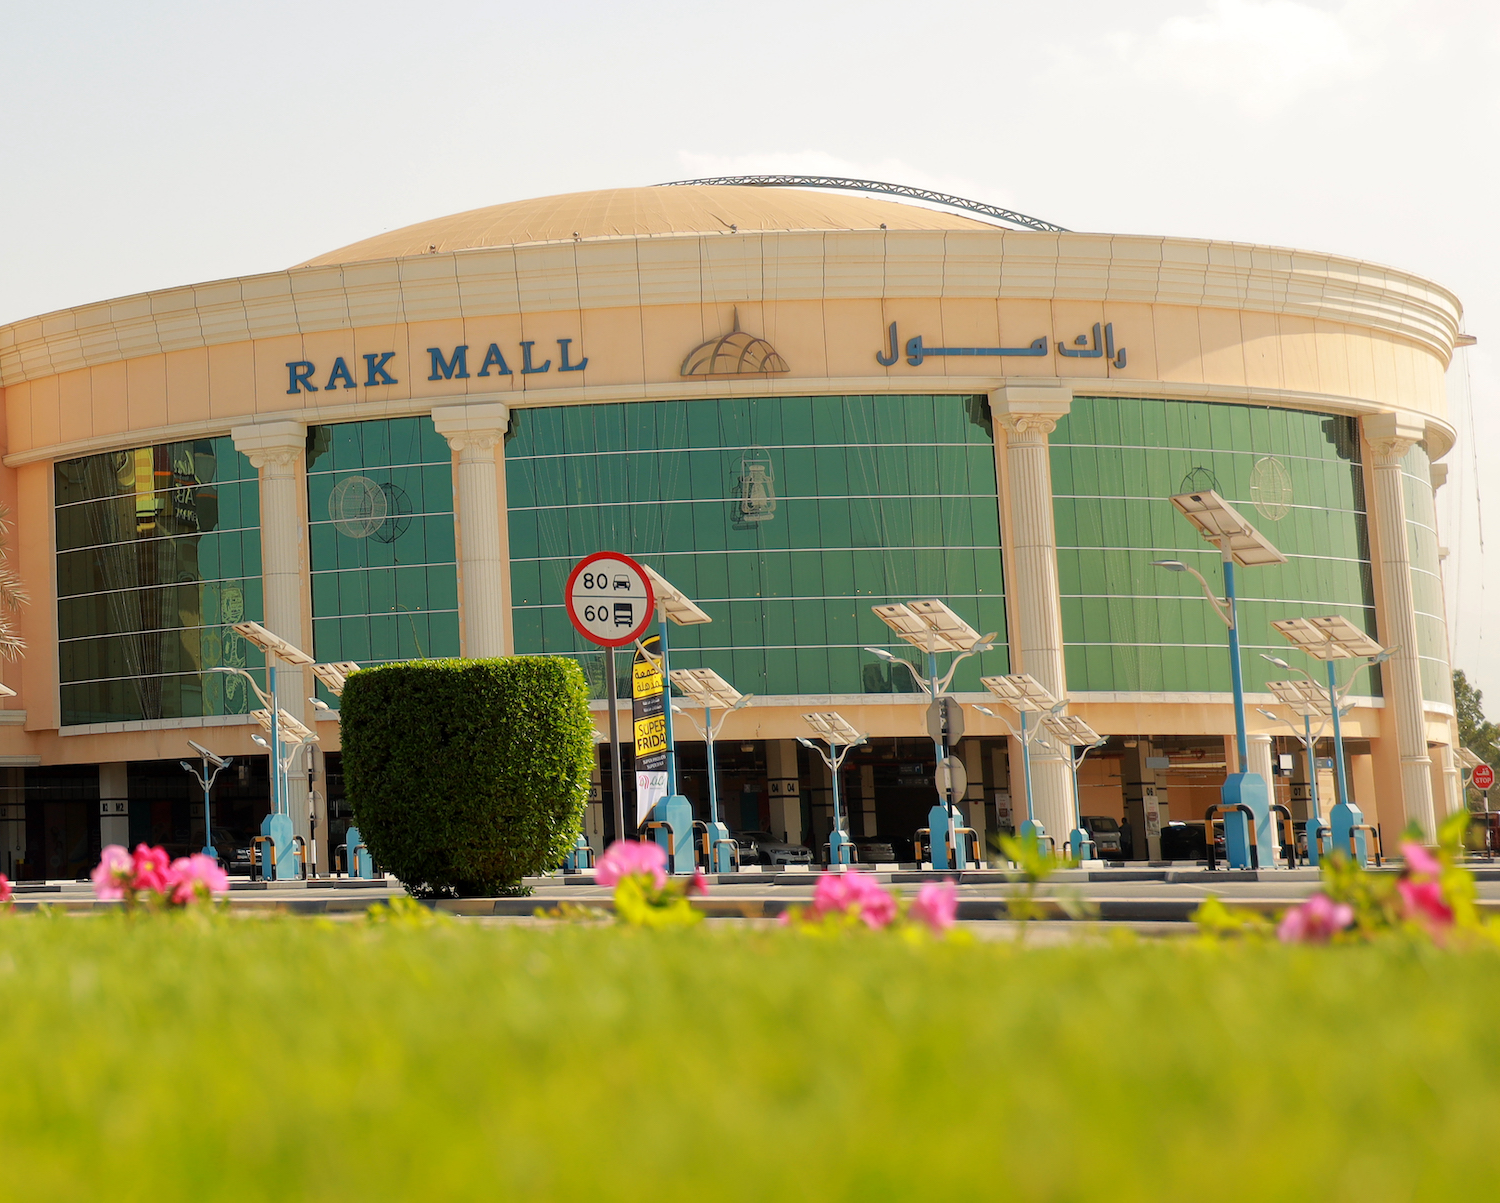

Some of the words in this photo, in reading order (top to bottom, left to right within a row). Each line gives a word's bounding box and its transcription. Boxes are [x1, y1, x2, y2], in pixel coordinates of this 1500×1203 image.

[876, 321, 1048, 366] مول
[1058, 322, 1127, 369] راك
[286, 351, 398, 395] RAK
[427, 338, 589, 381] MALL
[583, 573, 608, 590] 80
[584, 605, 609, 622] 60
[638, 719, 666, 737] SUPER
[637, 733, 667, 751] FRIDA
[1476, 767, 1490, 776] قف
